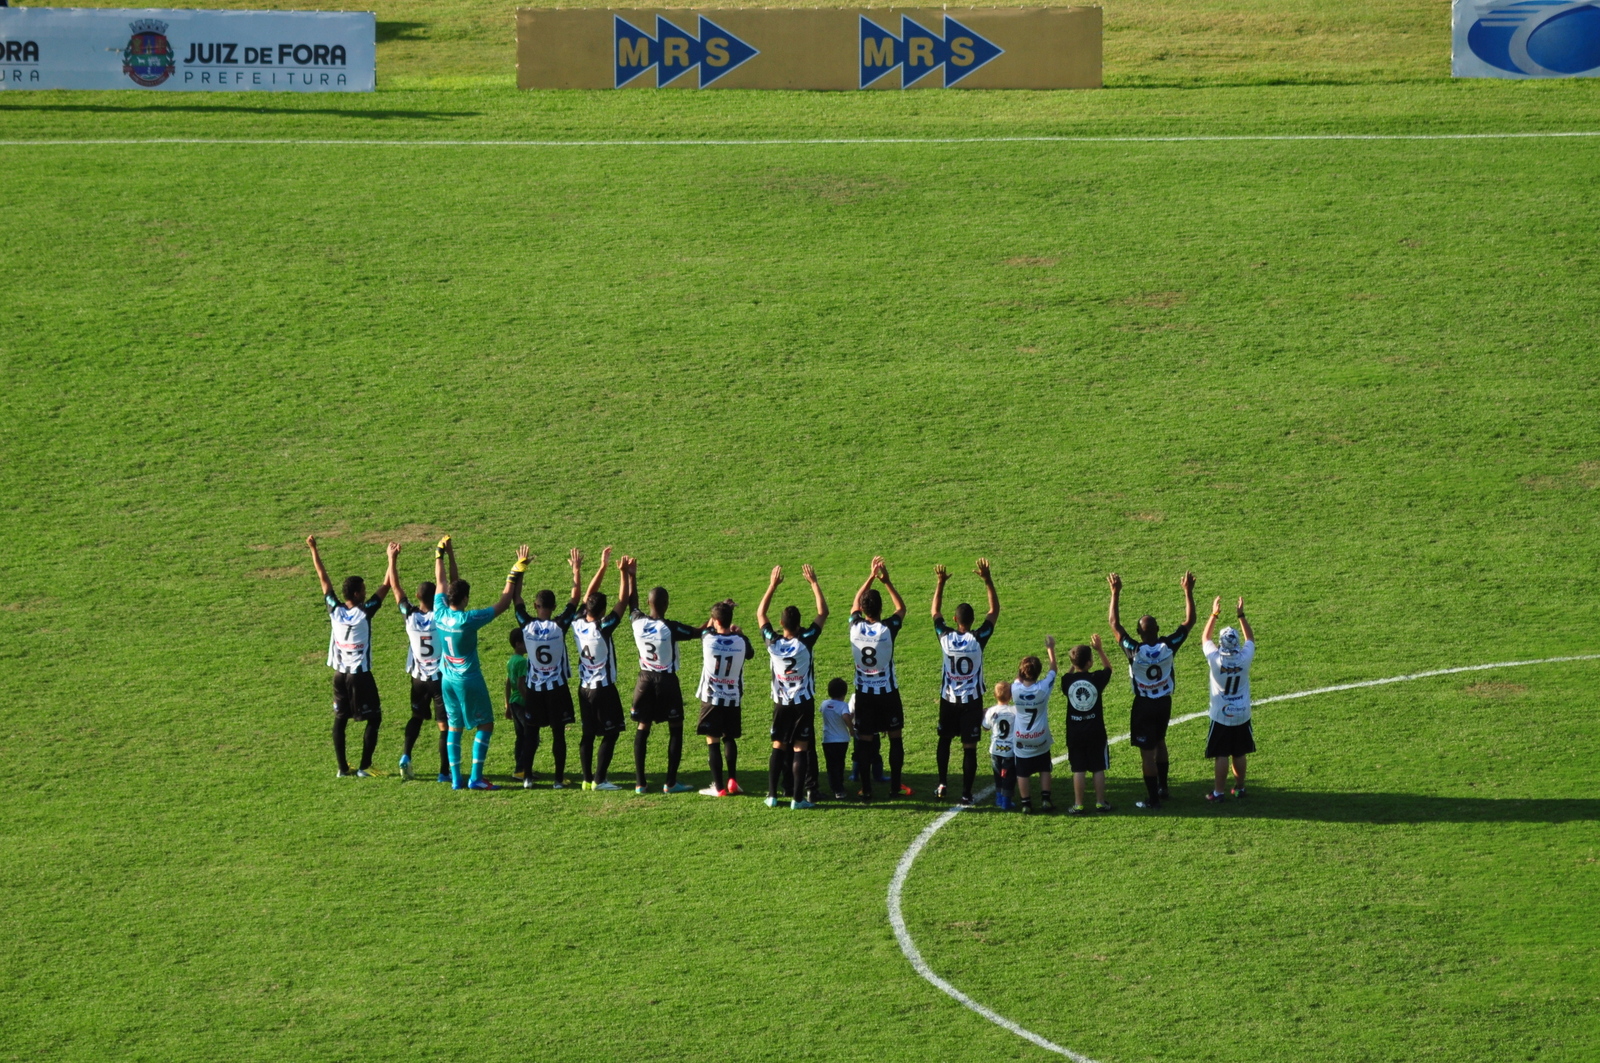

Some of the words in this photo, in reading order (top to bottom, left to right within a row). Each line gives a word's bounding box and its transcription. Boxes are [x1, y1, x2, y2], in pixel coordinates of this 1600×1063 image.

[0, 40, 39, 62] RA
[183, 43, 238, 64] JUIZ
[244, 47, 273, 64] DE
[278, 44, 346, 65] FORA
[618, 36, 730, 67] MRS
[863, 36, 975, 67] MRS
[184, 71, 347, 86] PREFEITURA
[420, 635, 434, 657] 5
[444, 636, 455, 657] 1
[535, 644, 553, 665] 6
[581, 644, 595, 665] 4
[645, 642, 658, 661] 3
[861, 646, 877, 667] 8
[713, 654, 733, 677] 11
[782, 656, 797, 675] 2
[947, 655, 974, 676] 10
[1146, 664, 1163, 682] 9
[1223, 675, 1241, 696] 11
[998, 719, 1010, 740] 9
[1024, 708, 1038, 731] 7
